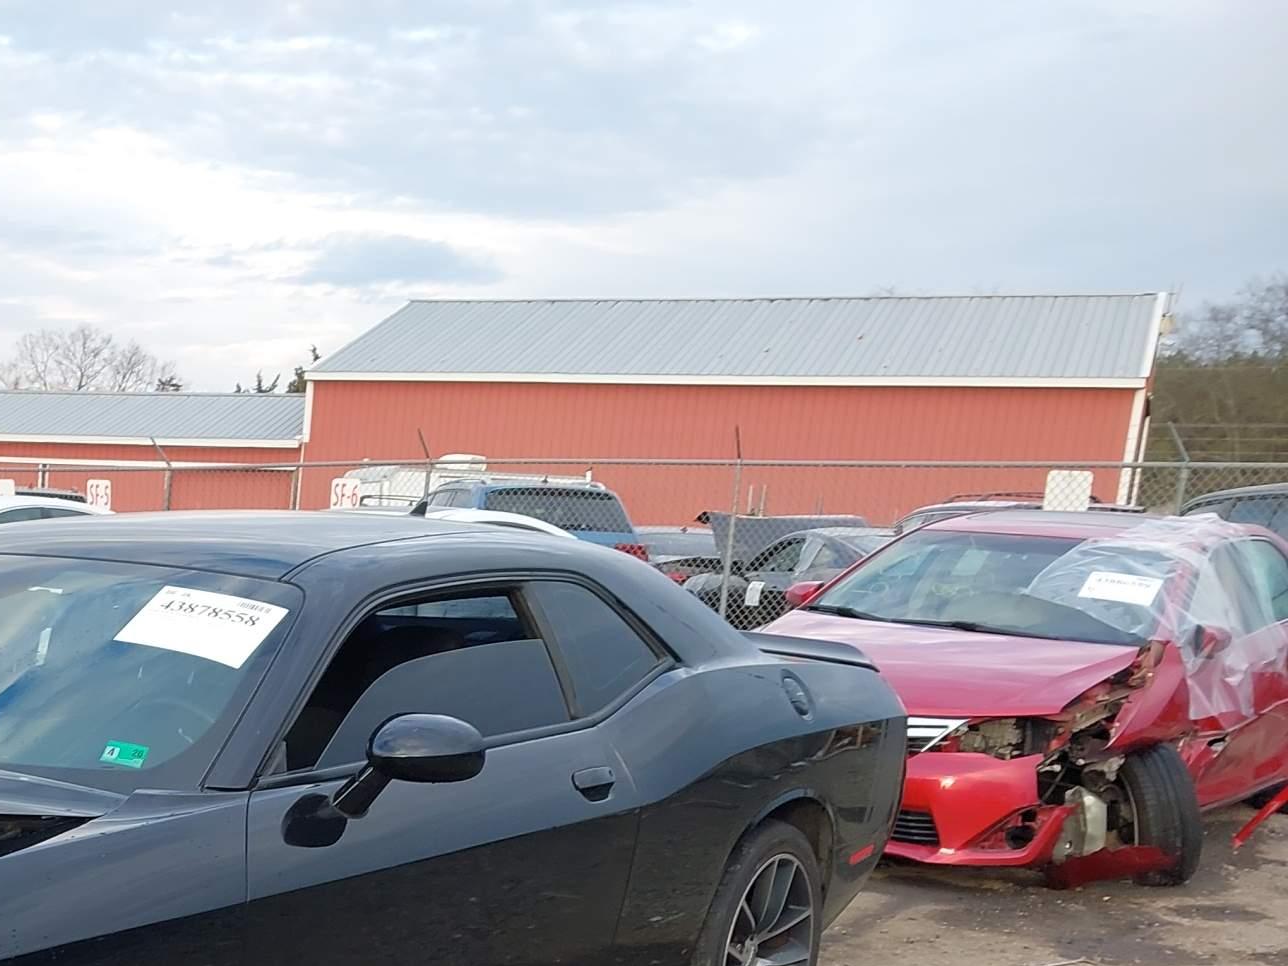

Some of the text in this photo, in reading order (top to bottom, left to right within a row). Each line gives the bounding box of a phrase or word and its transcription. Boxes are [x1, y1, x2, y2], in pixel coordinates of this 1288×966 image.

[89, 484, 109, 506] SF-5
[332, 483, 358, 507] SF-6
[160, 599, 260, 627] 43878558
